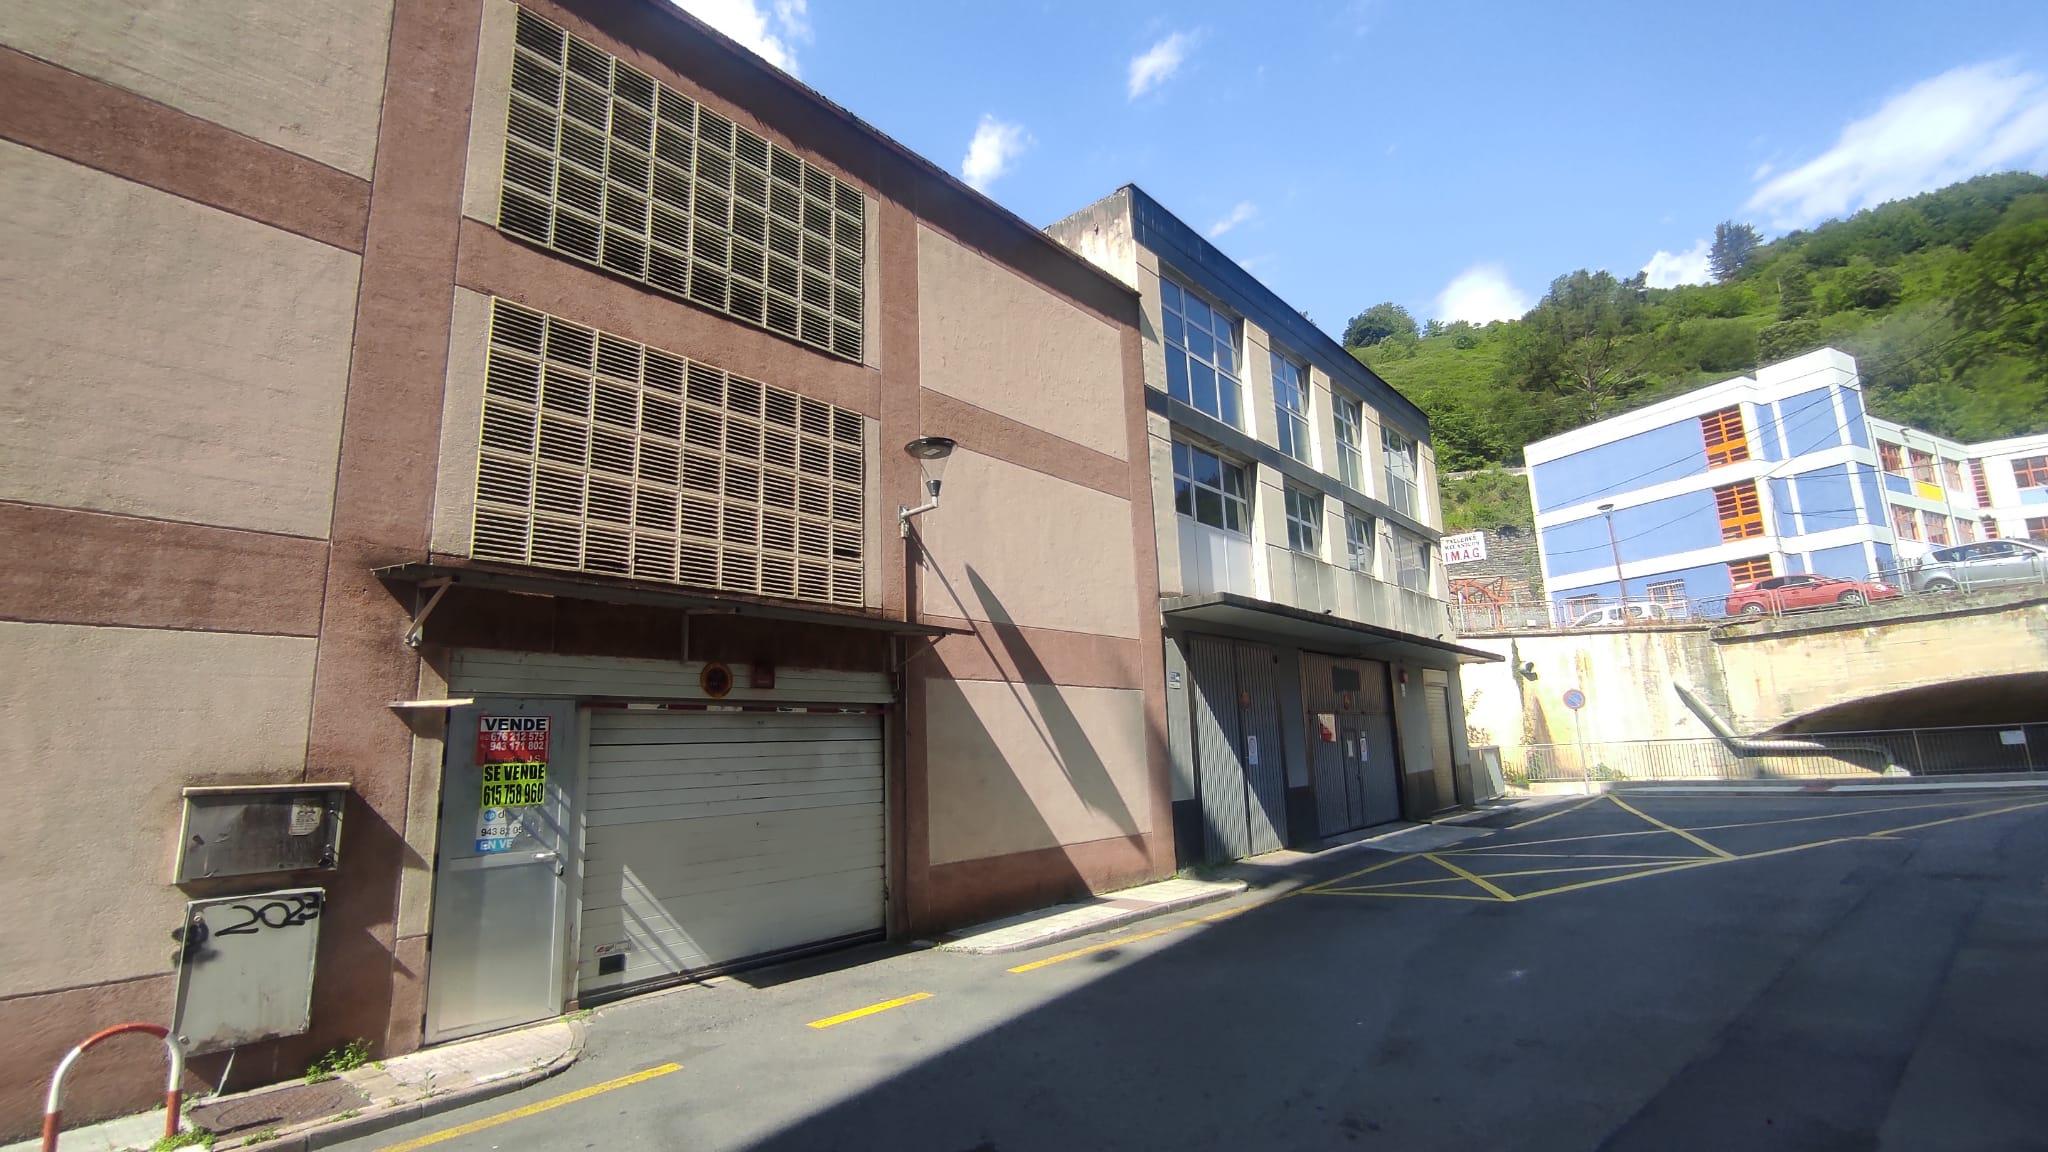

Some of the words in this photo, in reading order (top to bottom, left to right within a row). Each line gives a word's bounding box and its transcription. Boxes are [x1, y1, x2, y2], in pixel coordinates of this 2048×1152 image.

[485, 718, 547, 731] VENDE
[490, 732, 508, 741] 676
[509, 732, 527, 741] 212
[528, 732, 545, 741] 575
[489, 741, 507, 751] 943
[509, 741, 525, 751] 171
[528, 741, 545, 750] 802
[484, 765, 501, 782] SE
[503, 764, 545, 781] VENDE
[483, 785, 502, 806] 615
[504, 783, 523, 805] 758
[524, 782, 544, 804] 960
[480, 827, 498, 837] 943
[480, 840, 497, 851] EN
[214, 893, 320, 937] 2023
